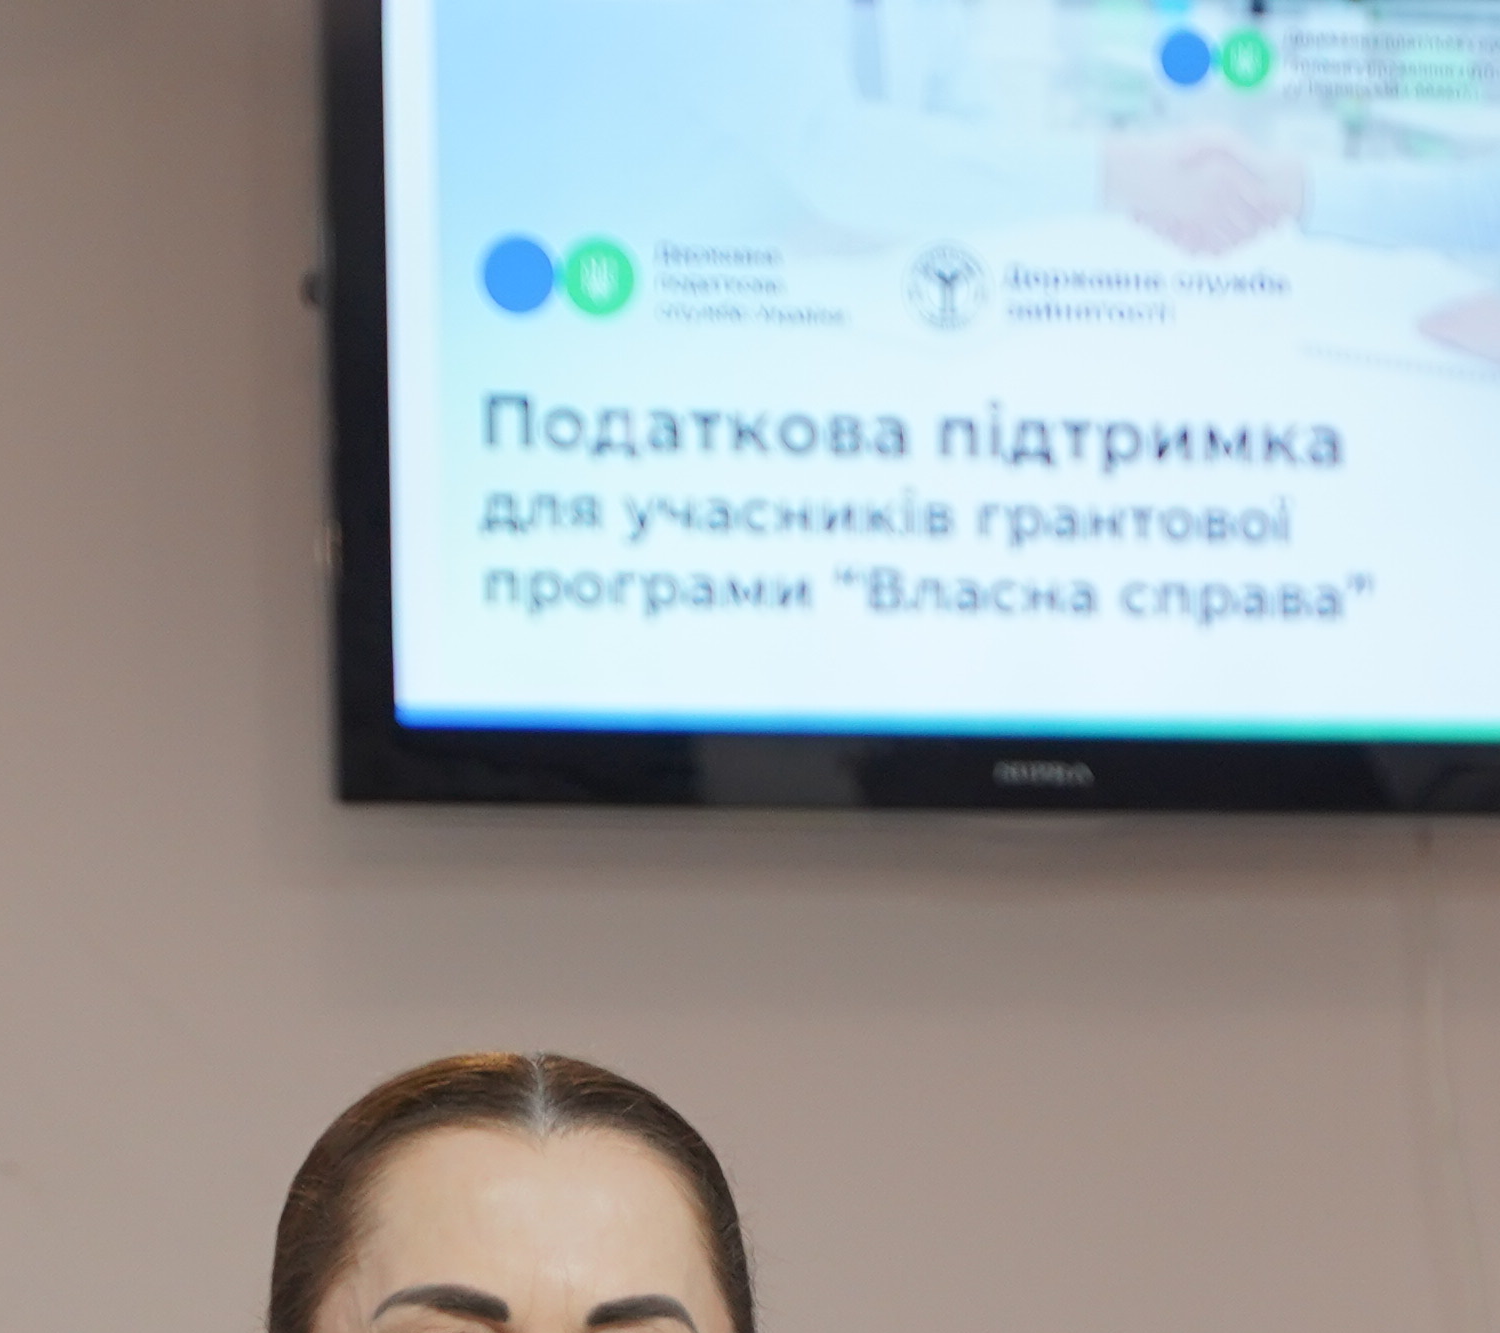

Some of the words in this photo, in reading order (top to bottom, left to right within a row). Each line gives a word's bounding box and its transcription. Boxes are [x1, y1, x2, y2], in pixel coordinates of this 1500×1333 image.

[481, 393, 910, 460] Податкова
[937, 402, 1345, 473] підтримка
[478, 488, 602, 538] для
[622, 487, 955, 543] учасників
[977, 495, 1293, 550] грантової
[481, 566, 814, 627] програми
